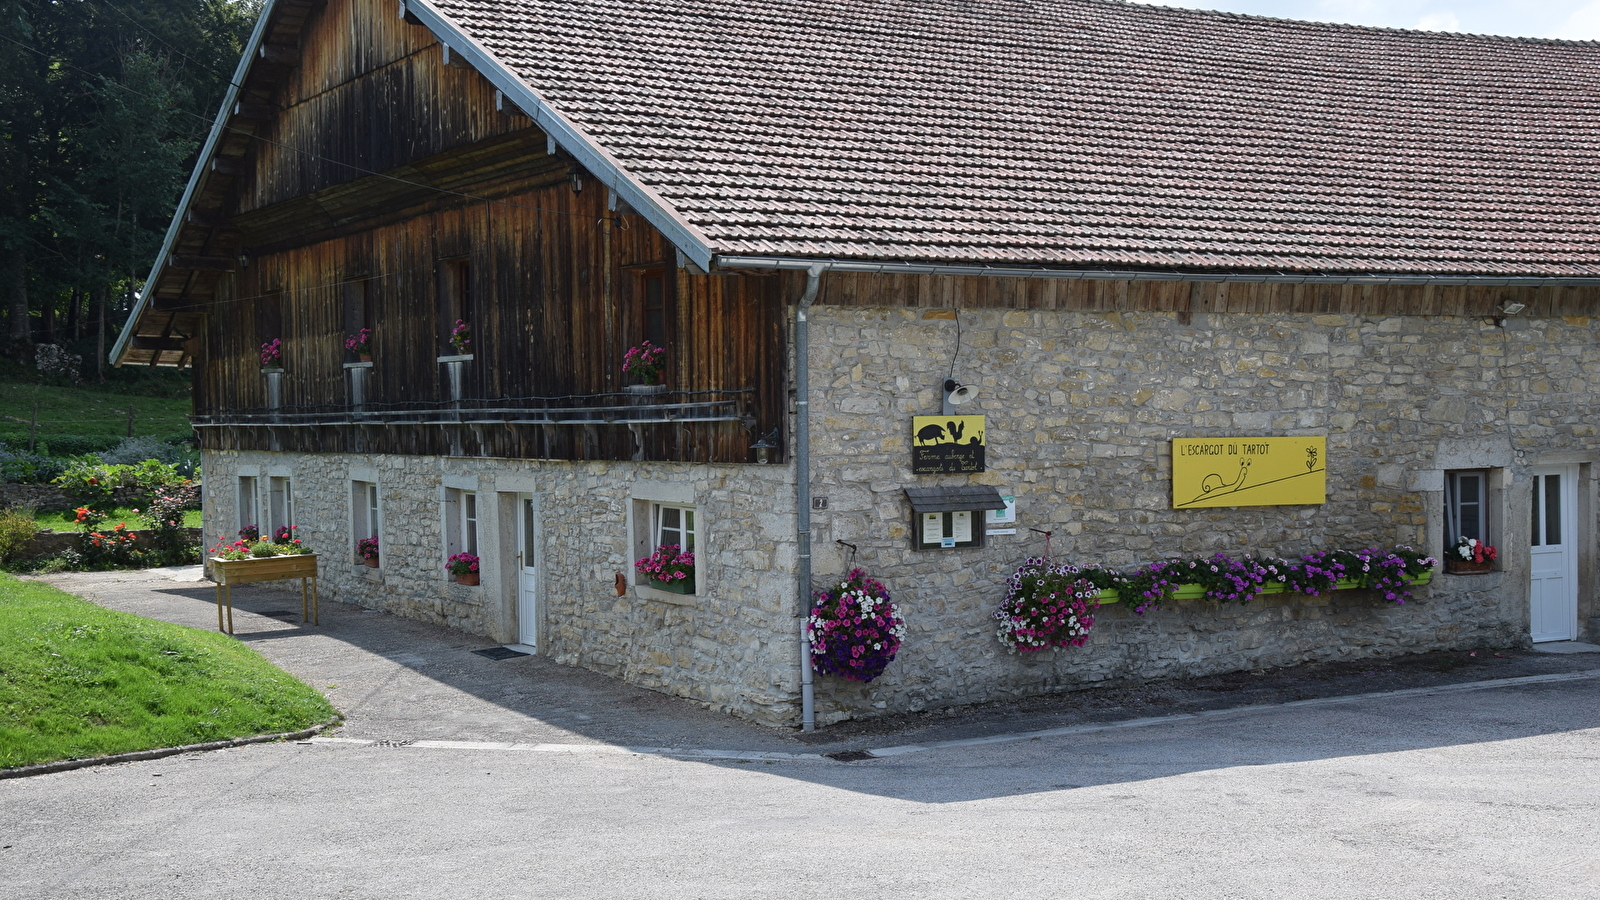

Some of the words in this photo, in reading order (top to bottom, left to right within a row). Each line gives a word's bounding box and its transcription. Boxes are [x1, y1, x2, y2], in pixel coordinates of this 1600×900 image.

[919, 449, 940, 460] Ferme
[1180, 444, 1223, 456] L'ESCARGOT
[1228, 444, 1238, 455] DU
[1242, 443, 1270, 455] TARTOT
